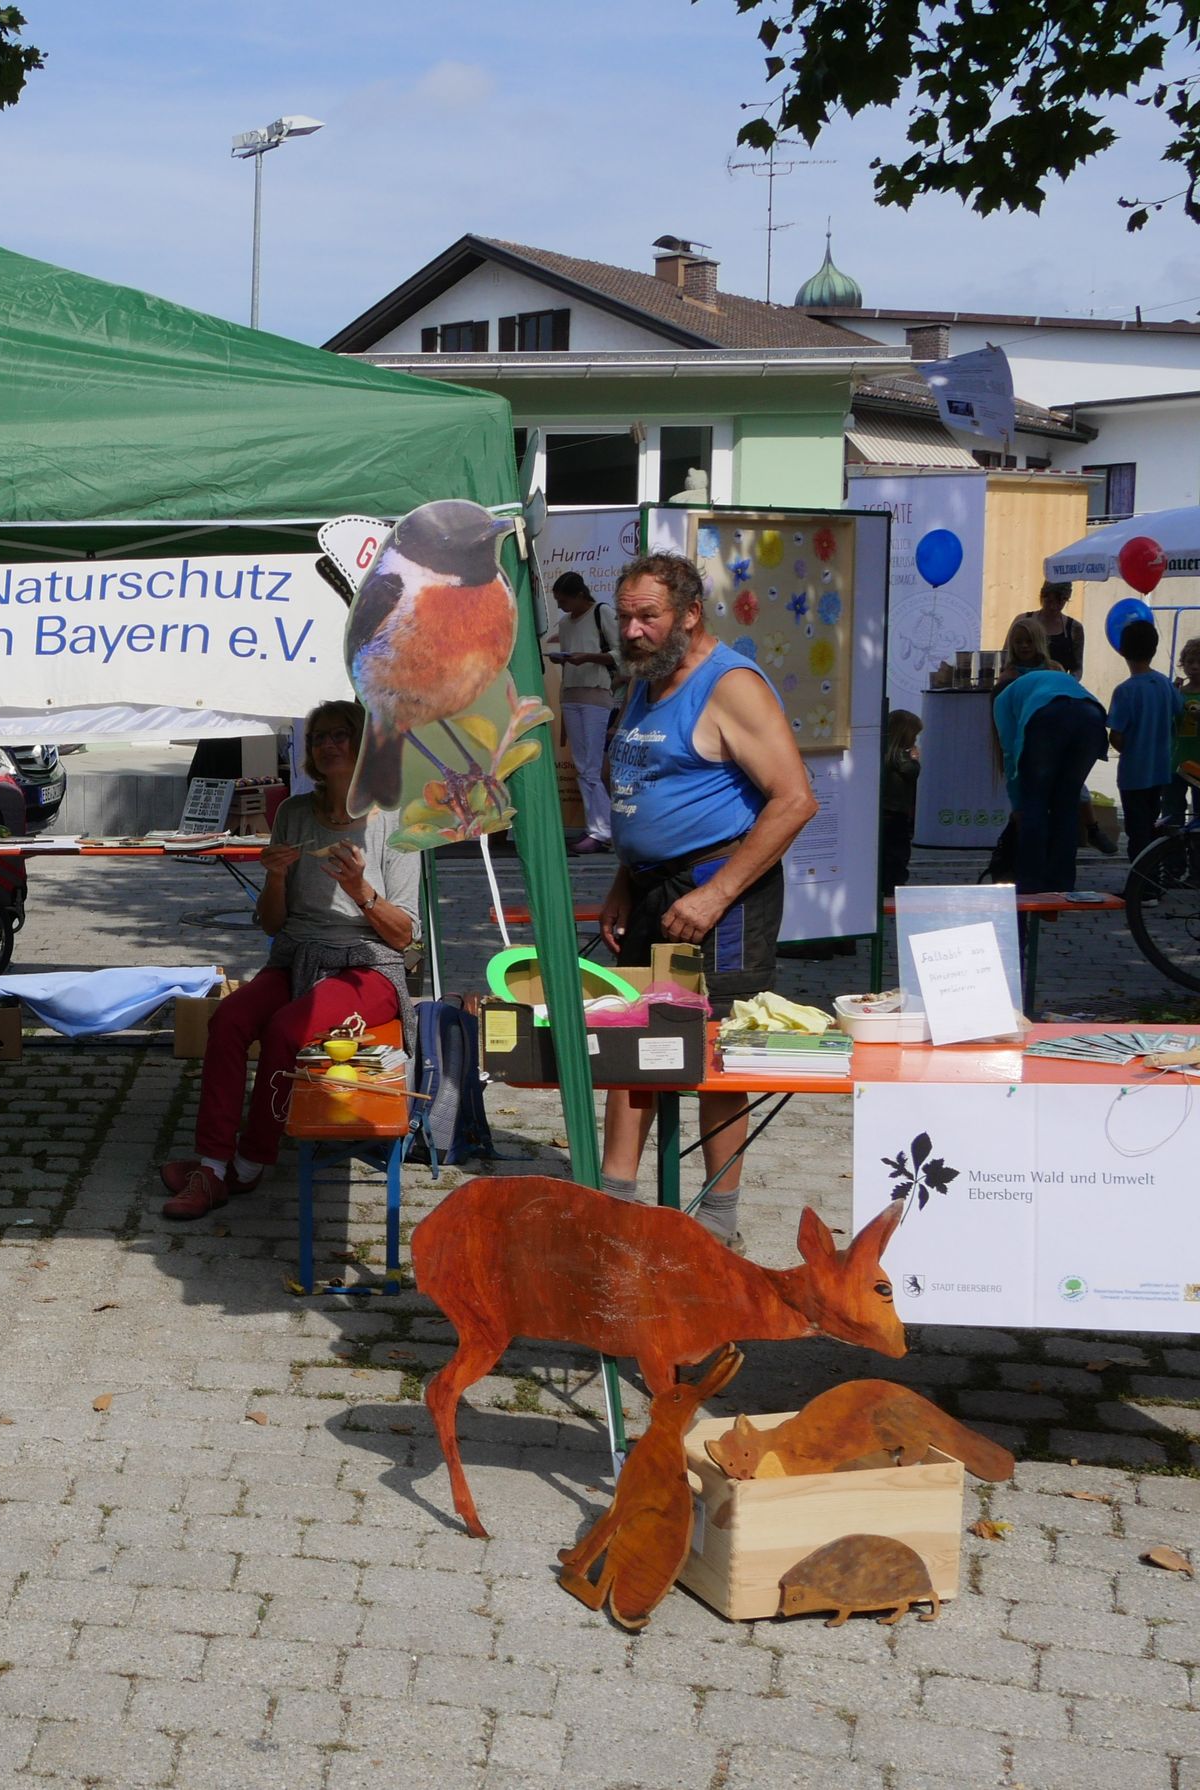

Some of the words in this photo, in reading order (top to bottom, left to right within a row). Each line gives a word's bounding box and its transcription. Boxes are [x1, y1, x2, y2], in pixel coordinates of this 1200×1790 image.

[589, 565, 622, 578] Rücke
[35, 615, 210, 664] Bayern
[229, 617, 317, 663] e.V.
[968, 1170, 1025, 1182] Museum
[1030, 1171, 1064, 1183] Wald
[1070, 1171, 1096, 1184] und
[1102, 1172, 1156, 1185] Umwelt
[968, 1188, 1033, 1204] Ebersberg
[931, 1283, 955, 1292] STADT
[957, 1283, 1002, 1293] EBERSBERG
